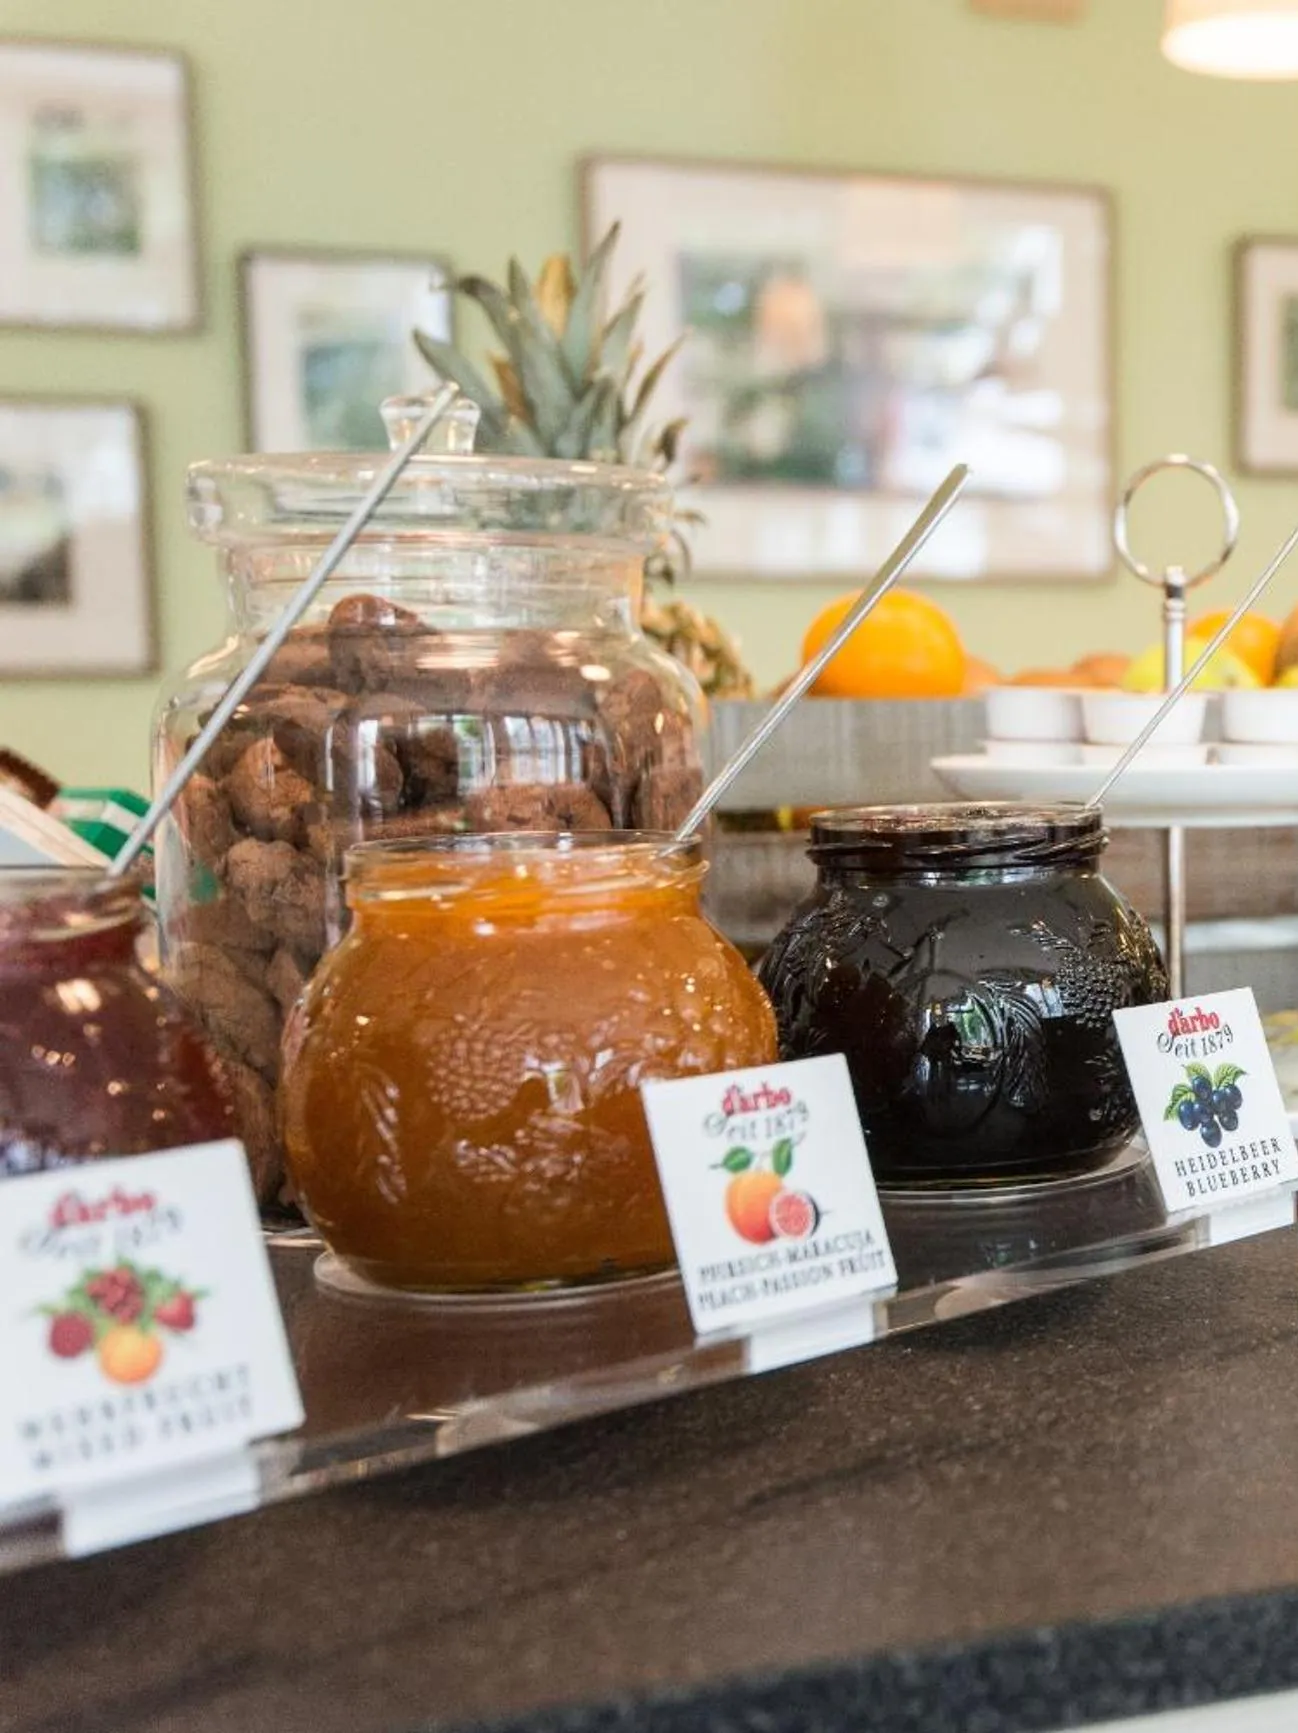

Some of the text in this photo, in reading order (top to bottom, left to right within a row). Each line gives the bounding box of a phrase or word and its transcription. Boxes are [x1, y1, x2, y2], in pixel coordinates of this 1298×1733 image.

[1156, 1023, 1234, 1059] Seit 1879
[1174, 1137, 1282, 1178] HEIDELBEER
[1186, 1159, 1282, 1197] BLUEBERRY
